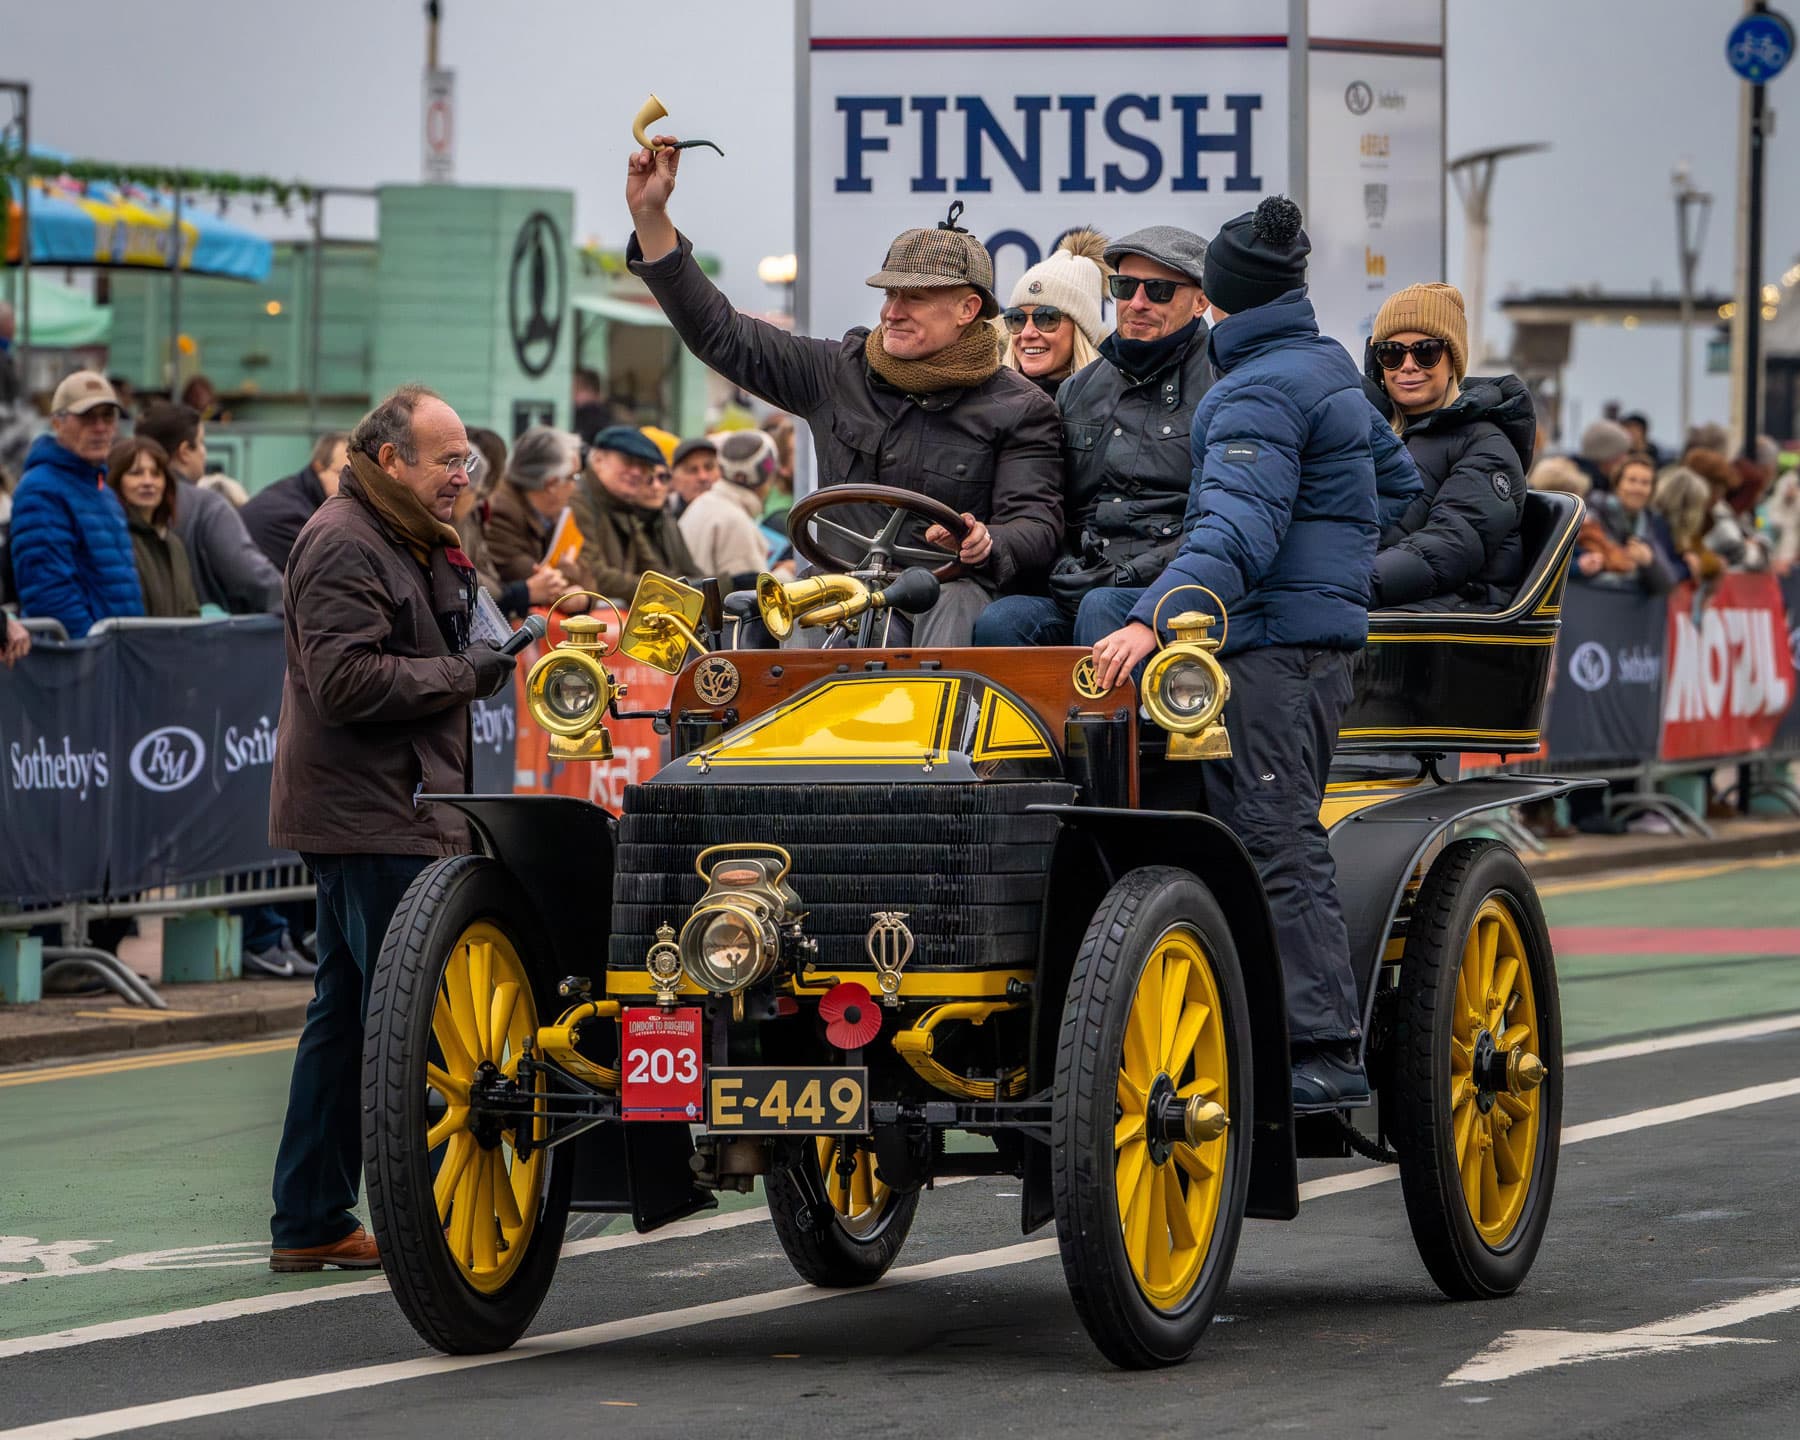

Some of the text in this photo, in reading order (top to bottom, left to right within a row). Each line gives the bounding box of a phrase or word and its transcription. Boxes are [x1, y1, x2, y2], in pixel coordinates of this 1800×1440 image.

[835, 93, 1262, 194] FINISH
[10, 735, 109, 801] Sotheby's
[629, 1020, 695, 1033] LONDON TO BRIGHTON
[627, 1048, 698, 1084] 203
[711, 1077, 862, 1126] E-449
